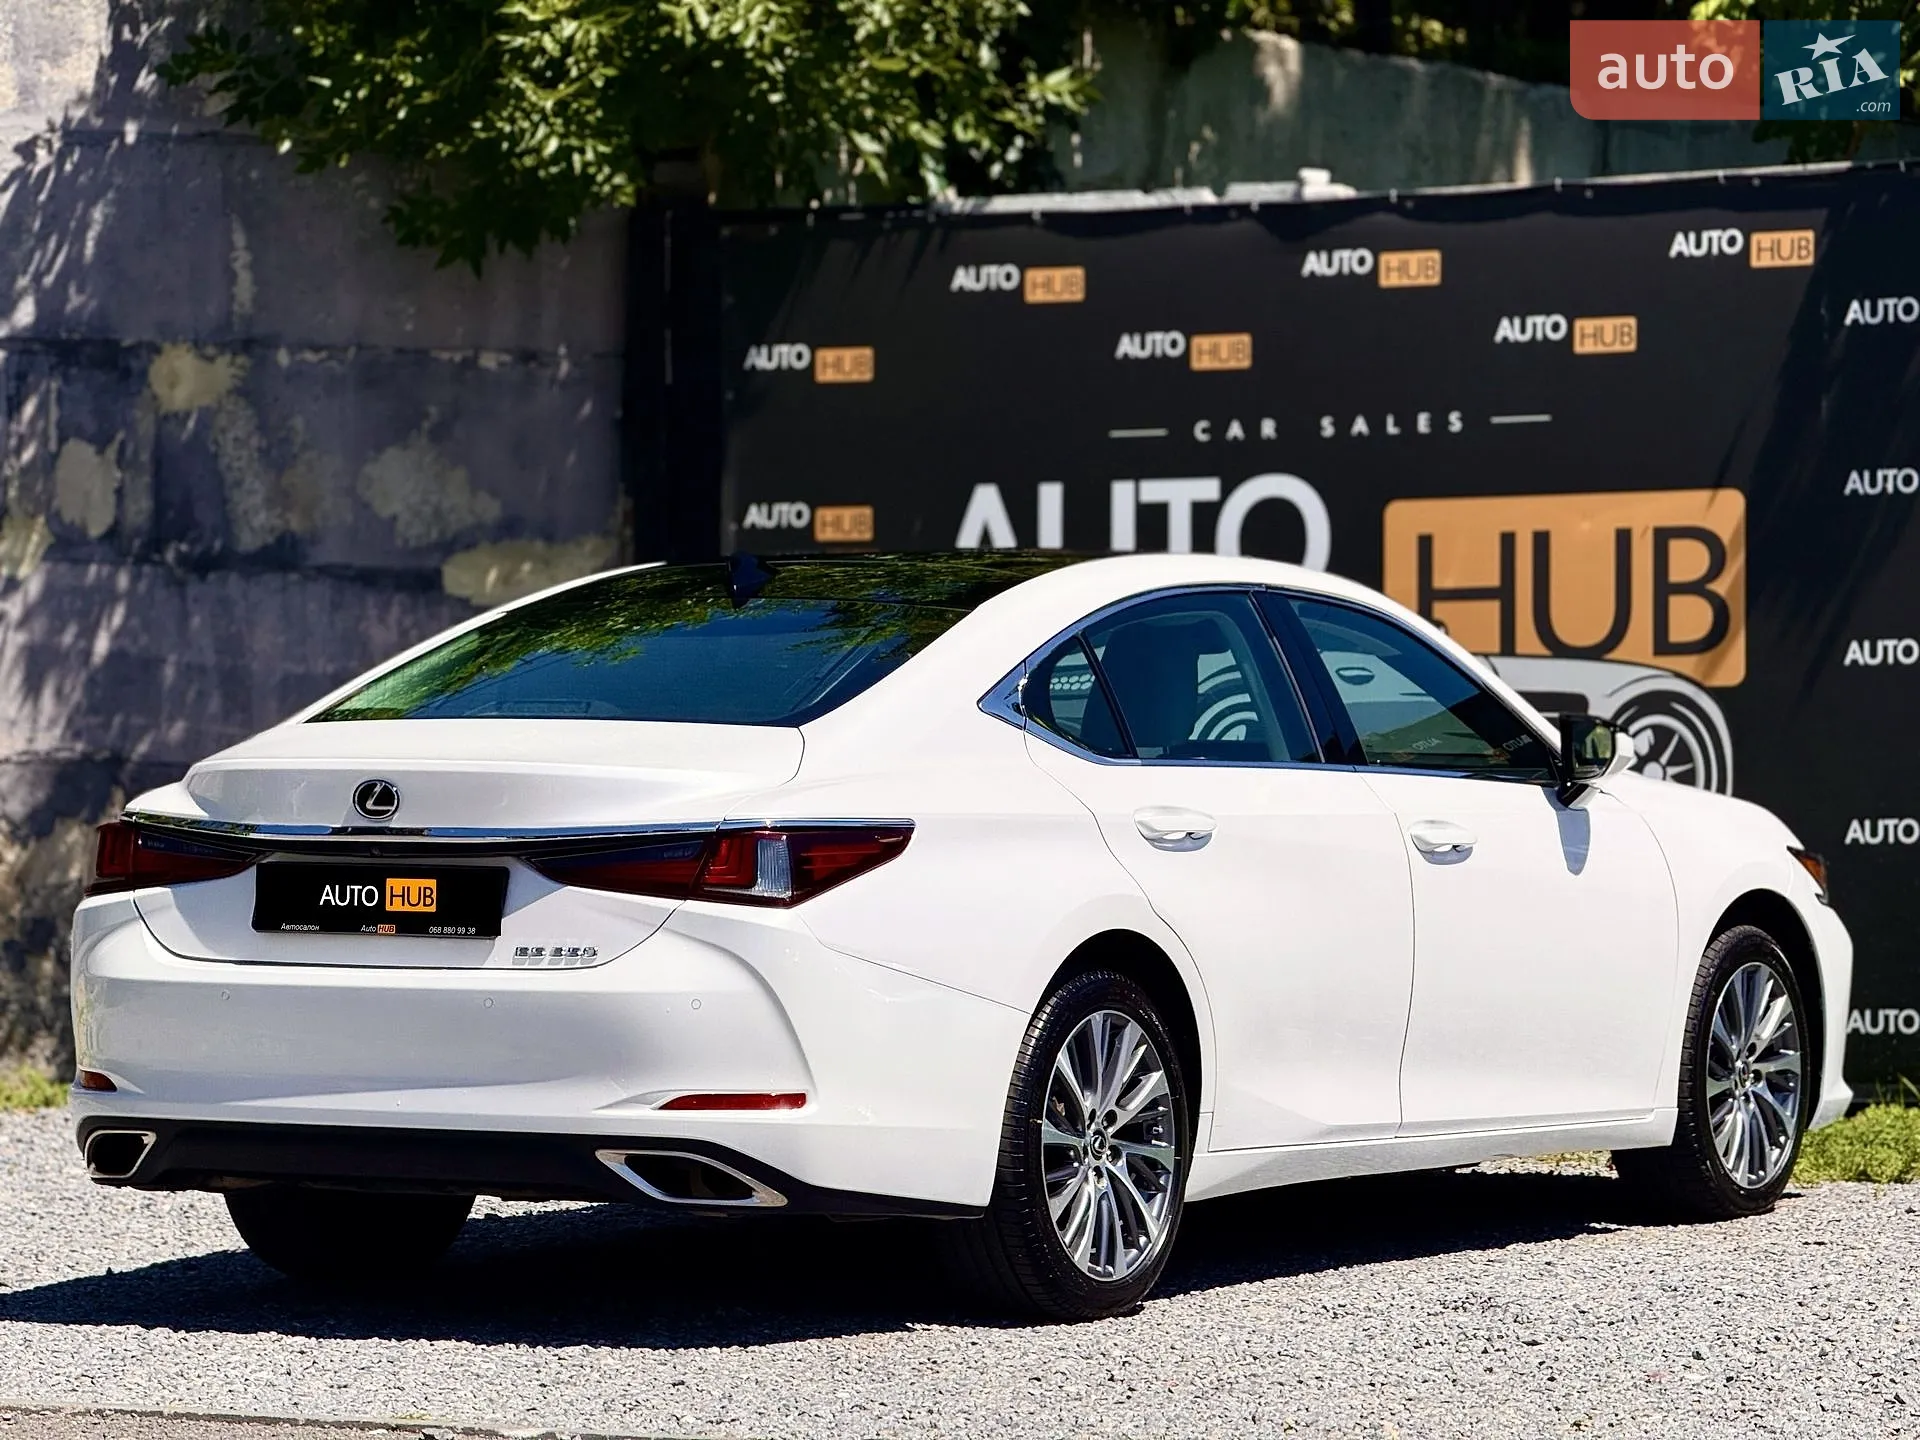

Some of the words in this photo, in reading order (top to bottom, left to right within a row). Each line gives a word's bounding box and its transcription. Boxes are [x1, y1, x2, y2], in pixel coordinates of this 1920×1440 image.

[1669, 228, 1744, 258] AUTO
[1756, 235, 1811, 262] HUB
[1301, 248, 1374, 278] AUTO
[1383, 255, 1436, 281] HUB
[951, 264, 1020, 292] AUTO
[1029, 272, 1082, 297] HUB
[1844, 296, 1920, 326] AUTO
[1494, 313, 1567, 344] AUTO
[1579, 321, 1634, 349] HUB
[743, 343, 812, 371] AUTO
[820, 352, 871, 377] HUB
[1114, 330, 1186, 359] AUTO
[1196, 338, 1248, 364] HUB
[1193, 418, 1278, 441] CAR
[1319, 410, 1463, 438] SALES
[1844, 467, 1920, 496] AUTO
[743, 501, 811, 530] AUTO
[820, 511, 871, 537] HUB
[1415, 525, 1731, 659] HUB
[1844, 638, 1920, 667] AUTO
[1845, 818, 1920, 845] AUTO
[319, 884, 379, 907] AUTO
[389, 885, 435, 907] HUB
[280, 922, 320, 932] Автосалон
[360, 924, 376, 933] Auto
[379, 925, 395, 933] HUB
[428, 926, 441, 934] 068
[443, 926, 456, 934] 880
[457, 926, 466, 935] 99
[466, 927, 476, 935] 38
[1846, 1008, 1920, 1035] AUTO
